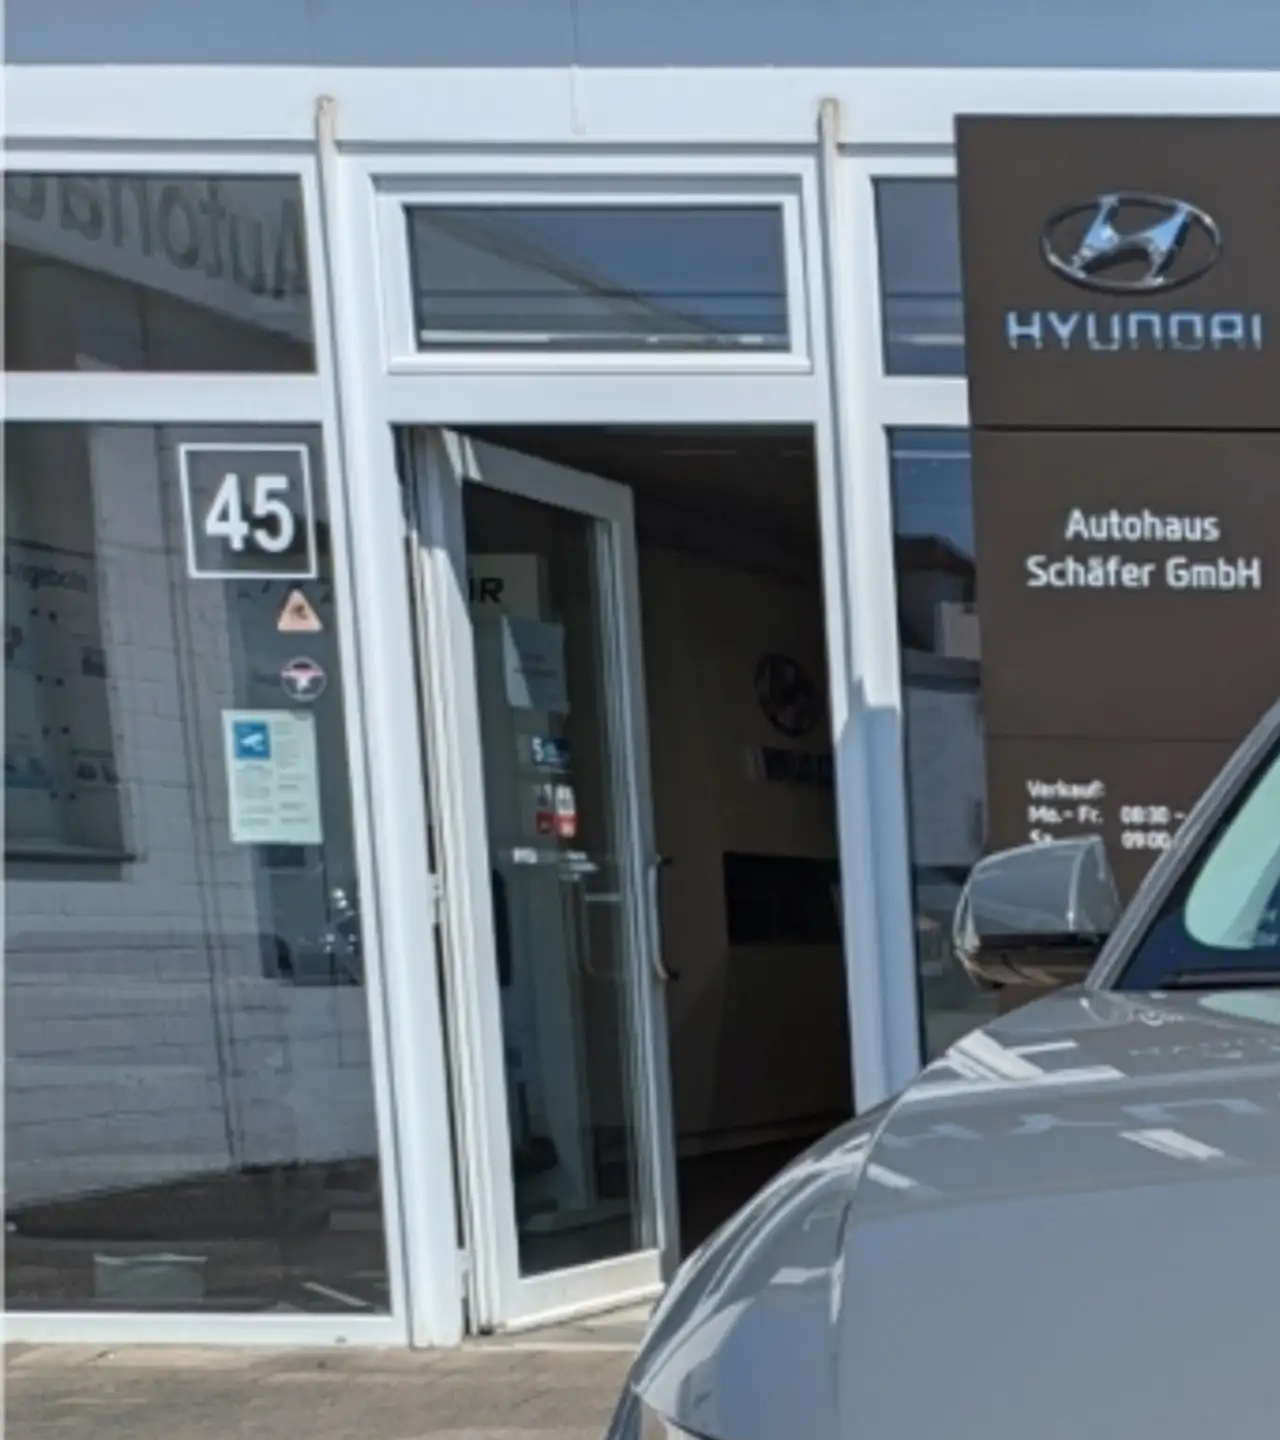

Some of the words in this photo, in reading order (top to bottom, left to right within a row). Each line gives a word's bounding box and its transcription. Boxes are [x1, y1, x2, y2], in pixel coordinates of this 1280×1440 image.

[1006, 310, 1263, 351] HYUNDAI
[204, 473, 294, 552] 45
[1064, 507, 1221, 541] Autohaus
[1025, 554, 1156, 588] Schäfer
[1165, 555, 1262, 590] GmbH
